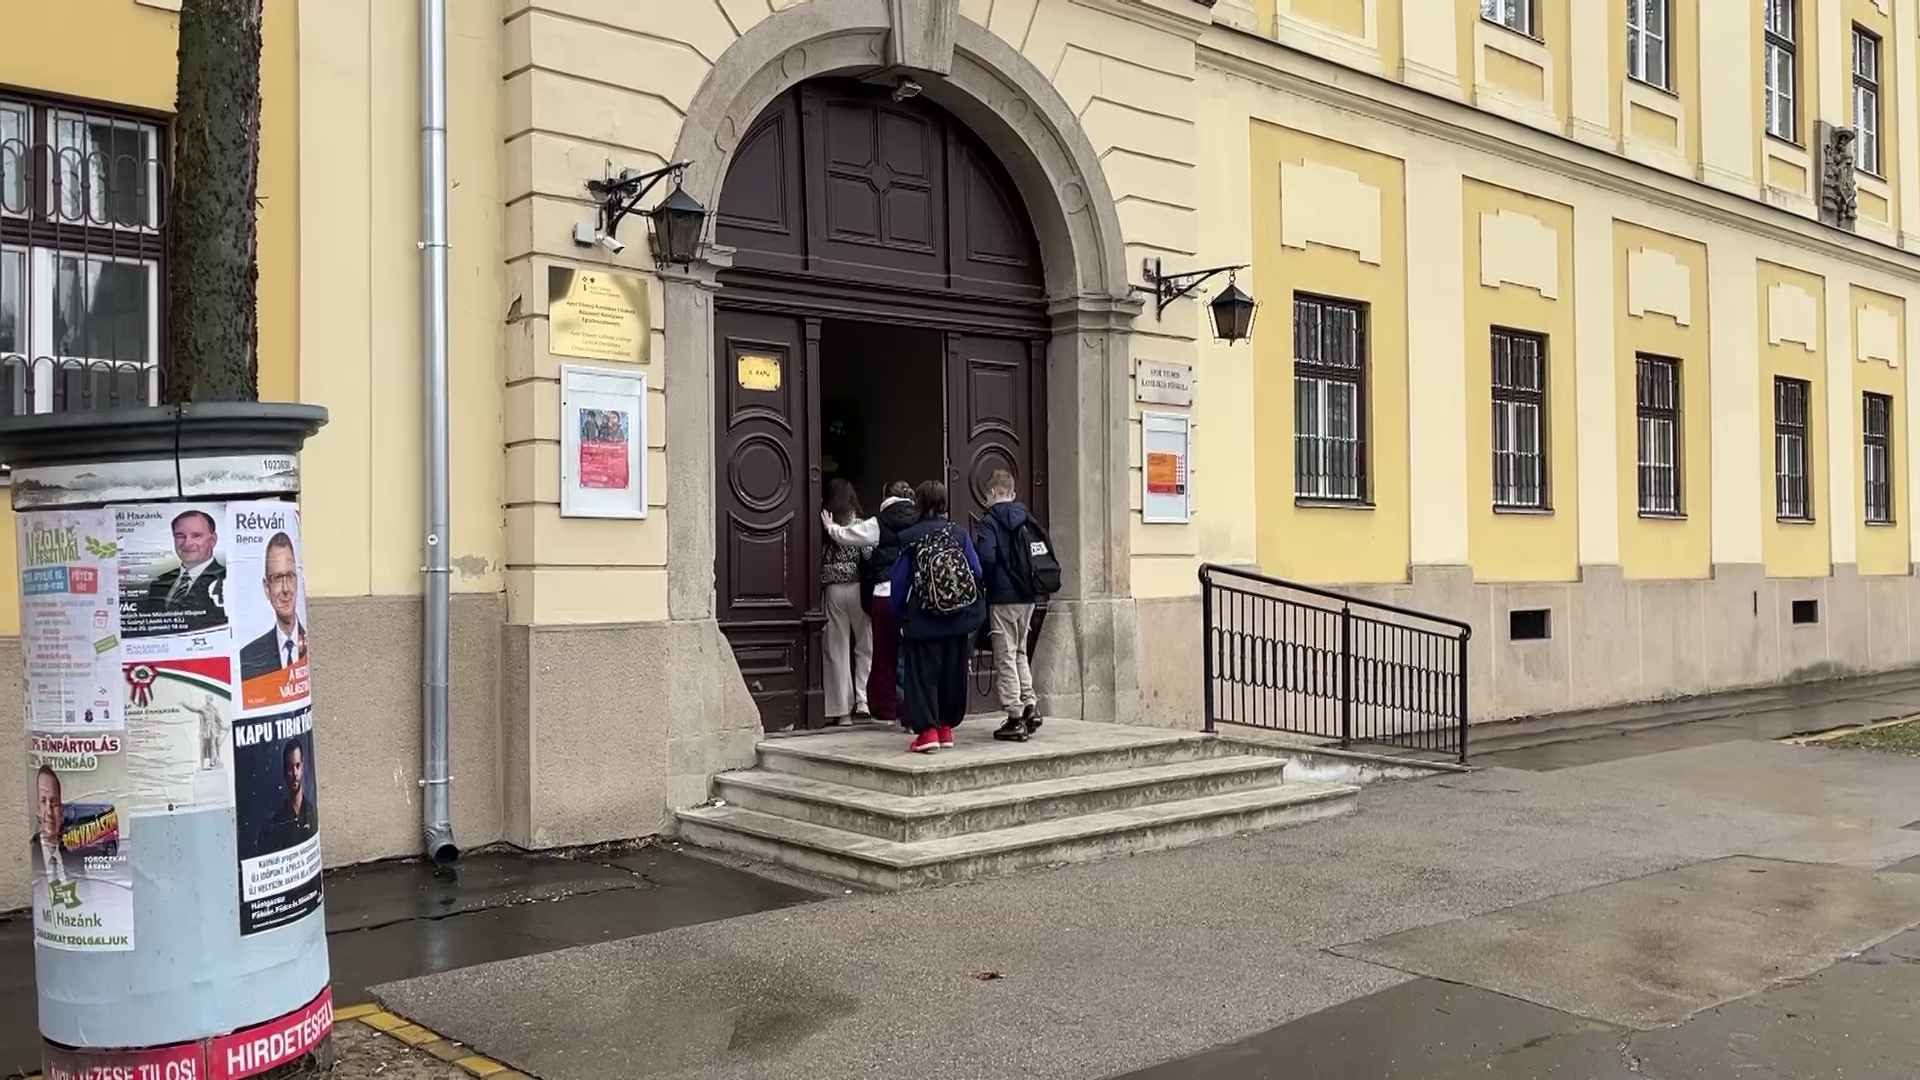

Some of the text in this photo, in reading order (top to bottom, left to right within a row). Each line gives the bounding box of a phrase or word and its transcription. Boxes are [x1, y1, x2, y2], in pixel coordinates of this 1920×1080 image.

[127, 511, 163, 520] Hazánk
[236, 512, 285, 530] Rétvári
[236, 535, 263, 543] Bence
[235, 722, 273, 748] KAPU
[41, 735, 119, 753] BŰNPÁRTOLÁS
[260, 866, 285, 879] IDŐPONT
[248, 884, 257, 895] ÚJ
[257, 878, 284, 893] HELYSZÍN
[43, 908, 102, 927] Mi Hazánk
[67, 936, 128, 945] SZOLGÁLJUK
